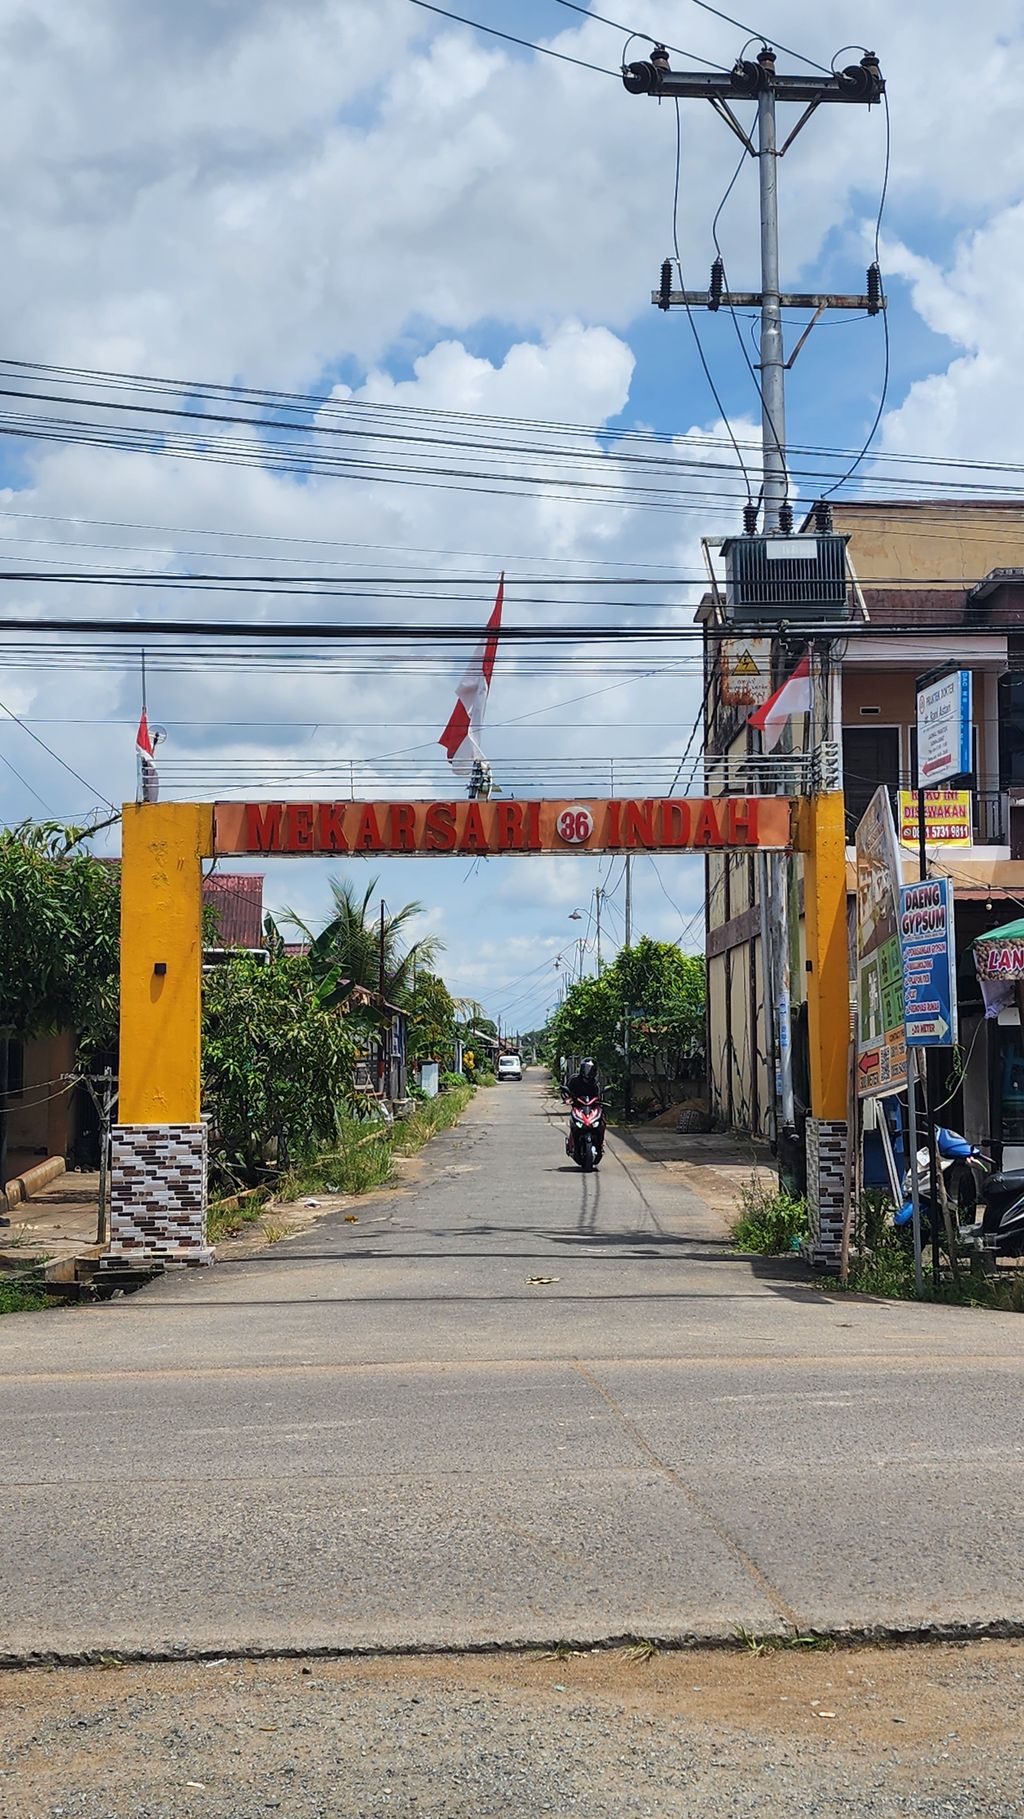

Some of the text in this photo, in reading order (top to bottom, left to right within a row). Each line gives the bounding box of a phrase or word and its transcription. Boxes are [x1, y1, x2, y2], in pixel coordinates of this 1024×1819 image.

[911, 790, 939, 800] RKO
[244, 799, 759, 850] MEKARSARI 36 INDAH
[931, 826, 949, 838] 5731
[951, 826, 968, 838] 9811
[905, 884, 940, 912] DAENG
[902, 907, 945, 935] GYPSUM
